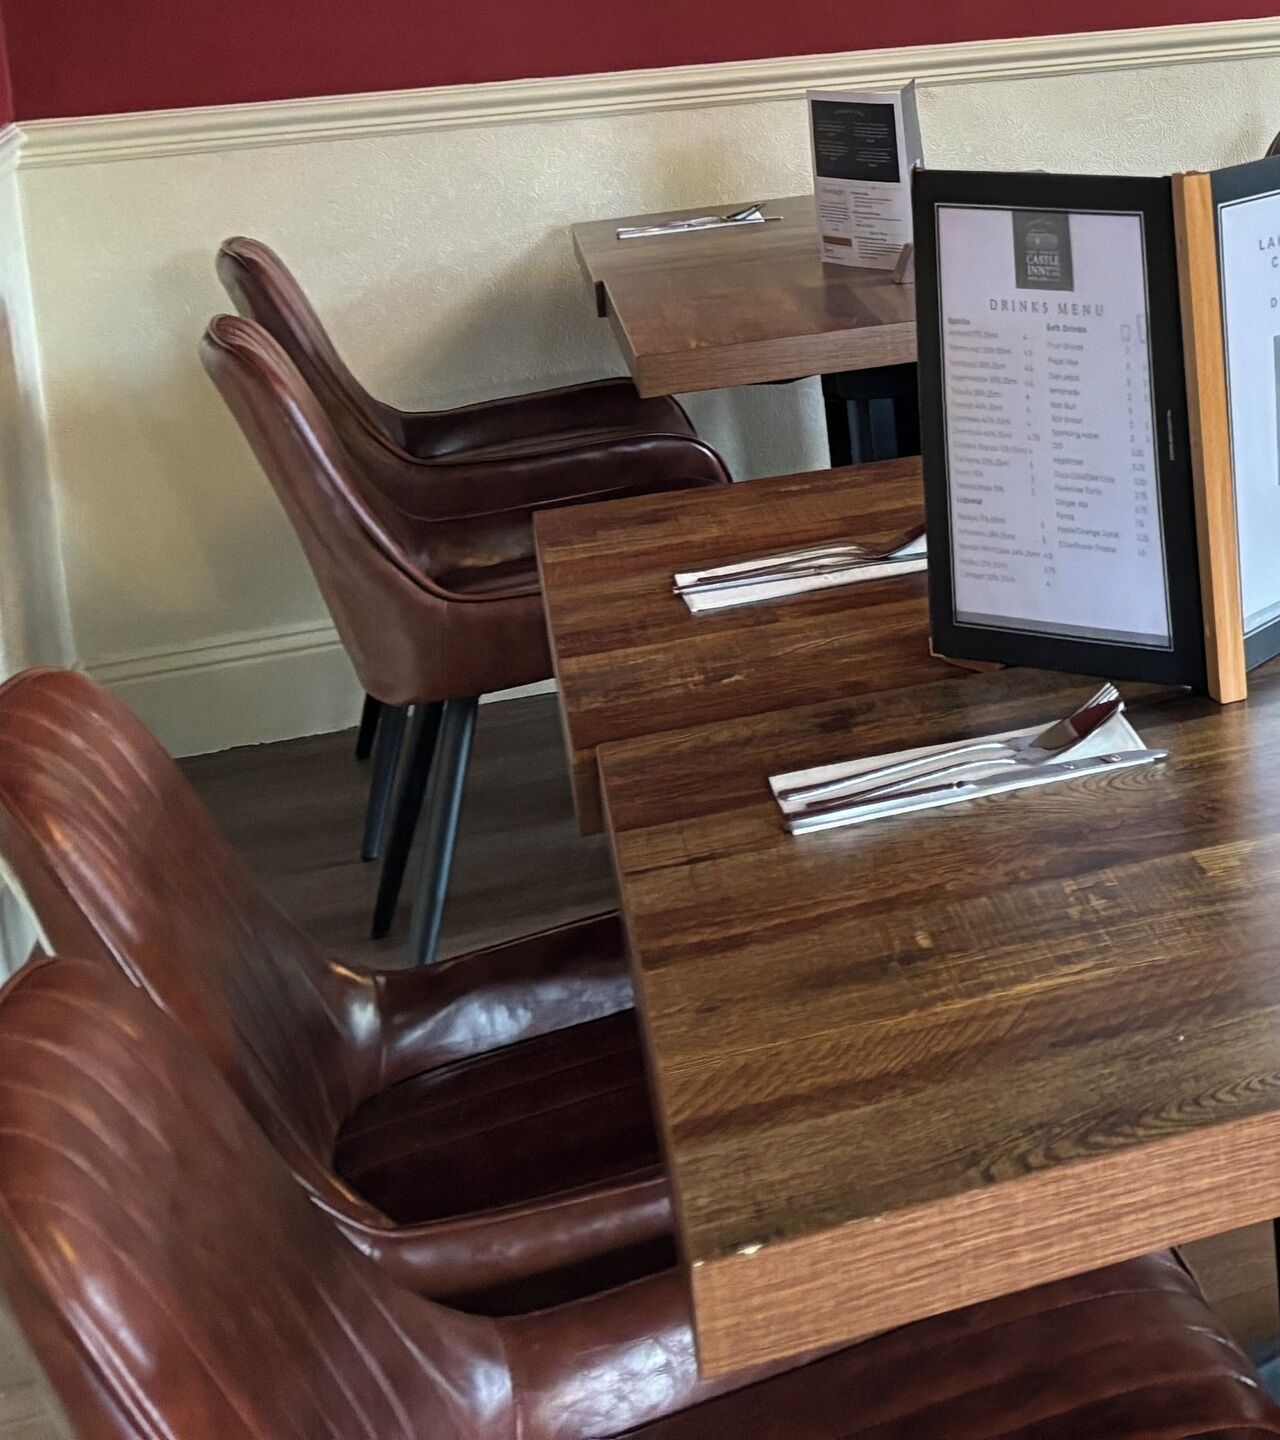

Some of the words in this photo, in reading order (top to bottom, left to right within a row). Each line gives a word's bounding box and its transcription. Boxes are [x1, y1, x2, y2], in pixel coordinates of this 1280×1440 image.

[1026, 254, 1060, 265] CASTLE
[1027, 265, 1045, 276] INN
[989, 298, 1049, 314] DRINKS
[1057, 303, 1104, 317] MENU
